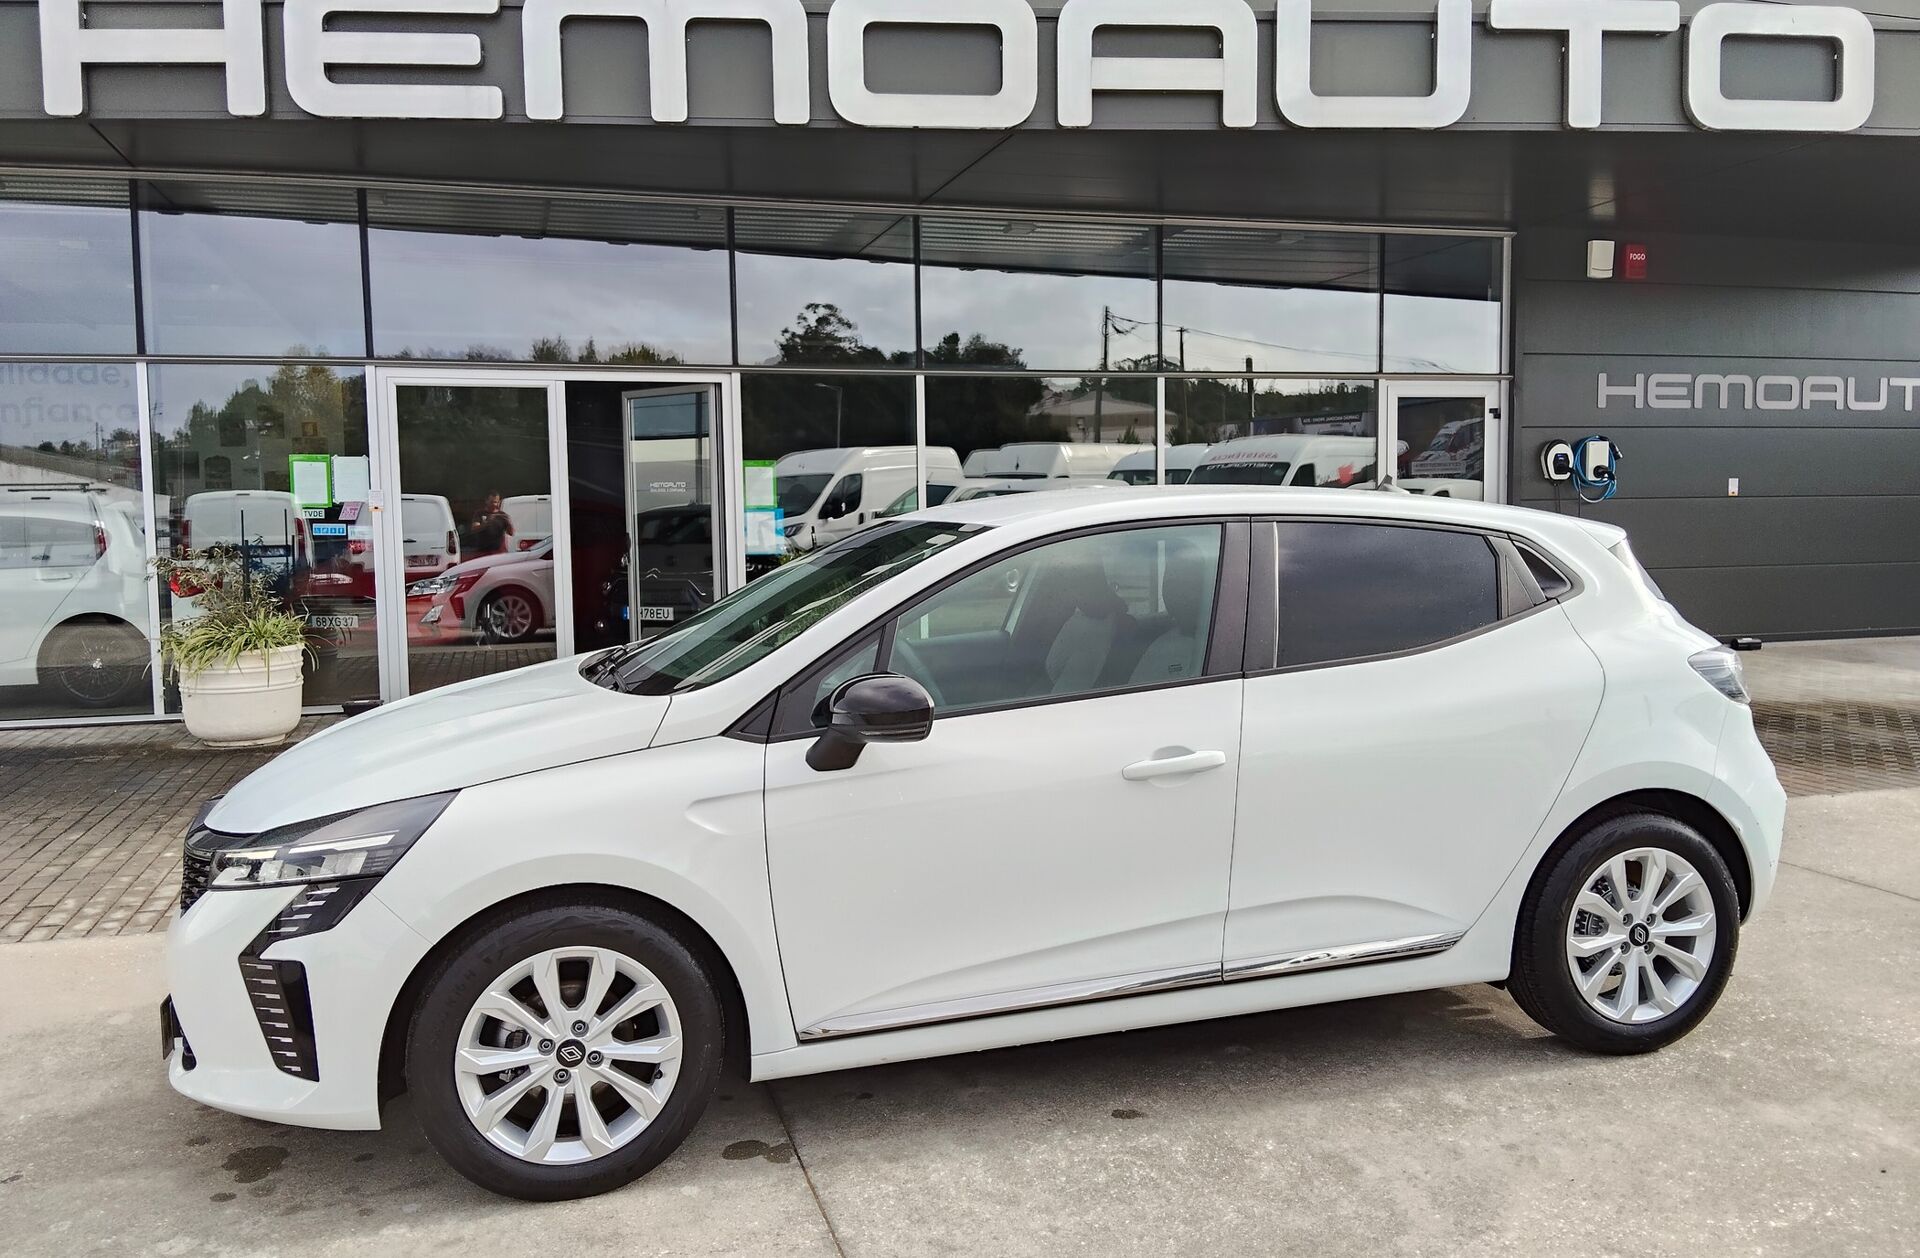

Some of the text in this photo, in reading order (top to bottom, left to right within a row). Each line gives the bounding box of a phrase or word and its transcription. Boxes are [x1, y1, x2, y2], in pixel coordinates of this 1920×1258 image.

[39, 0, 1876, 132] HEMOAUTO
[1629, 253, 1646, 261] FOGO
[1597, 372, 1920, 411] HEMOAUT
[304, 510, 324, 518] TVDE
[315, 616, 354, 628] 68XG37
